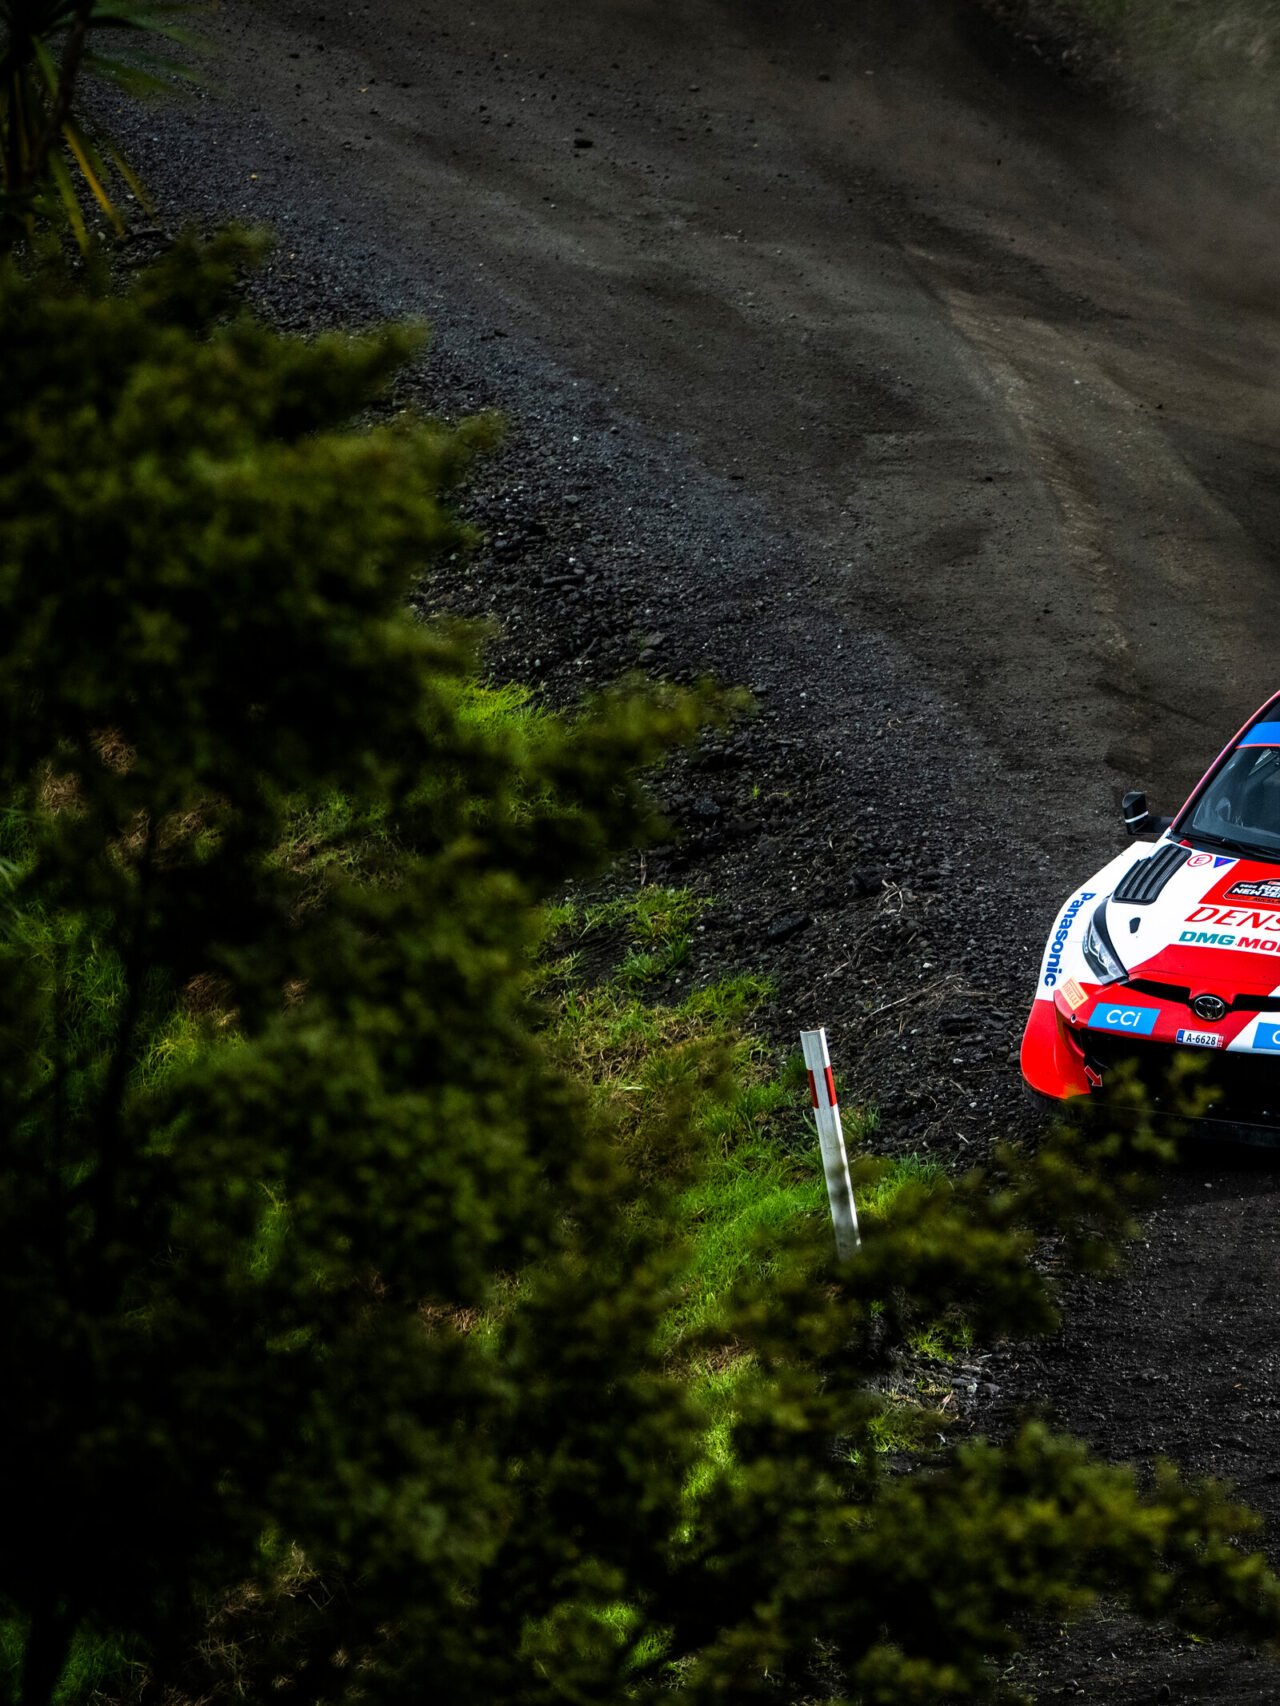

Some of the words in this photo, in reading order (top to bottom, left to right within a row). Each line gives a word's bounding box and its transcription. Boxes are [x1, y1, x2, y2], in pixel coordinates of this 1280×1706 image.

[1232, 888, 1262, 896] NEW
[1044, 892, 1097, 987] Panasonic
[1179, 930, 1237, 946] DMG
[1186, 1033, 1216, 1046] A-6628
